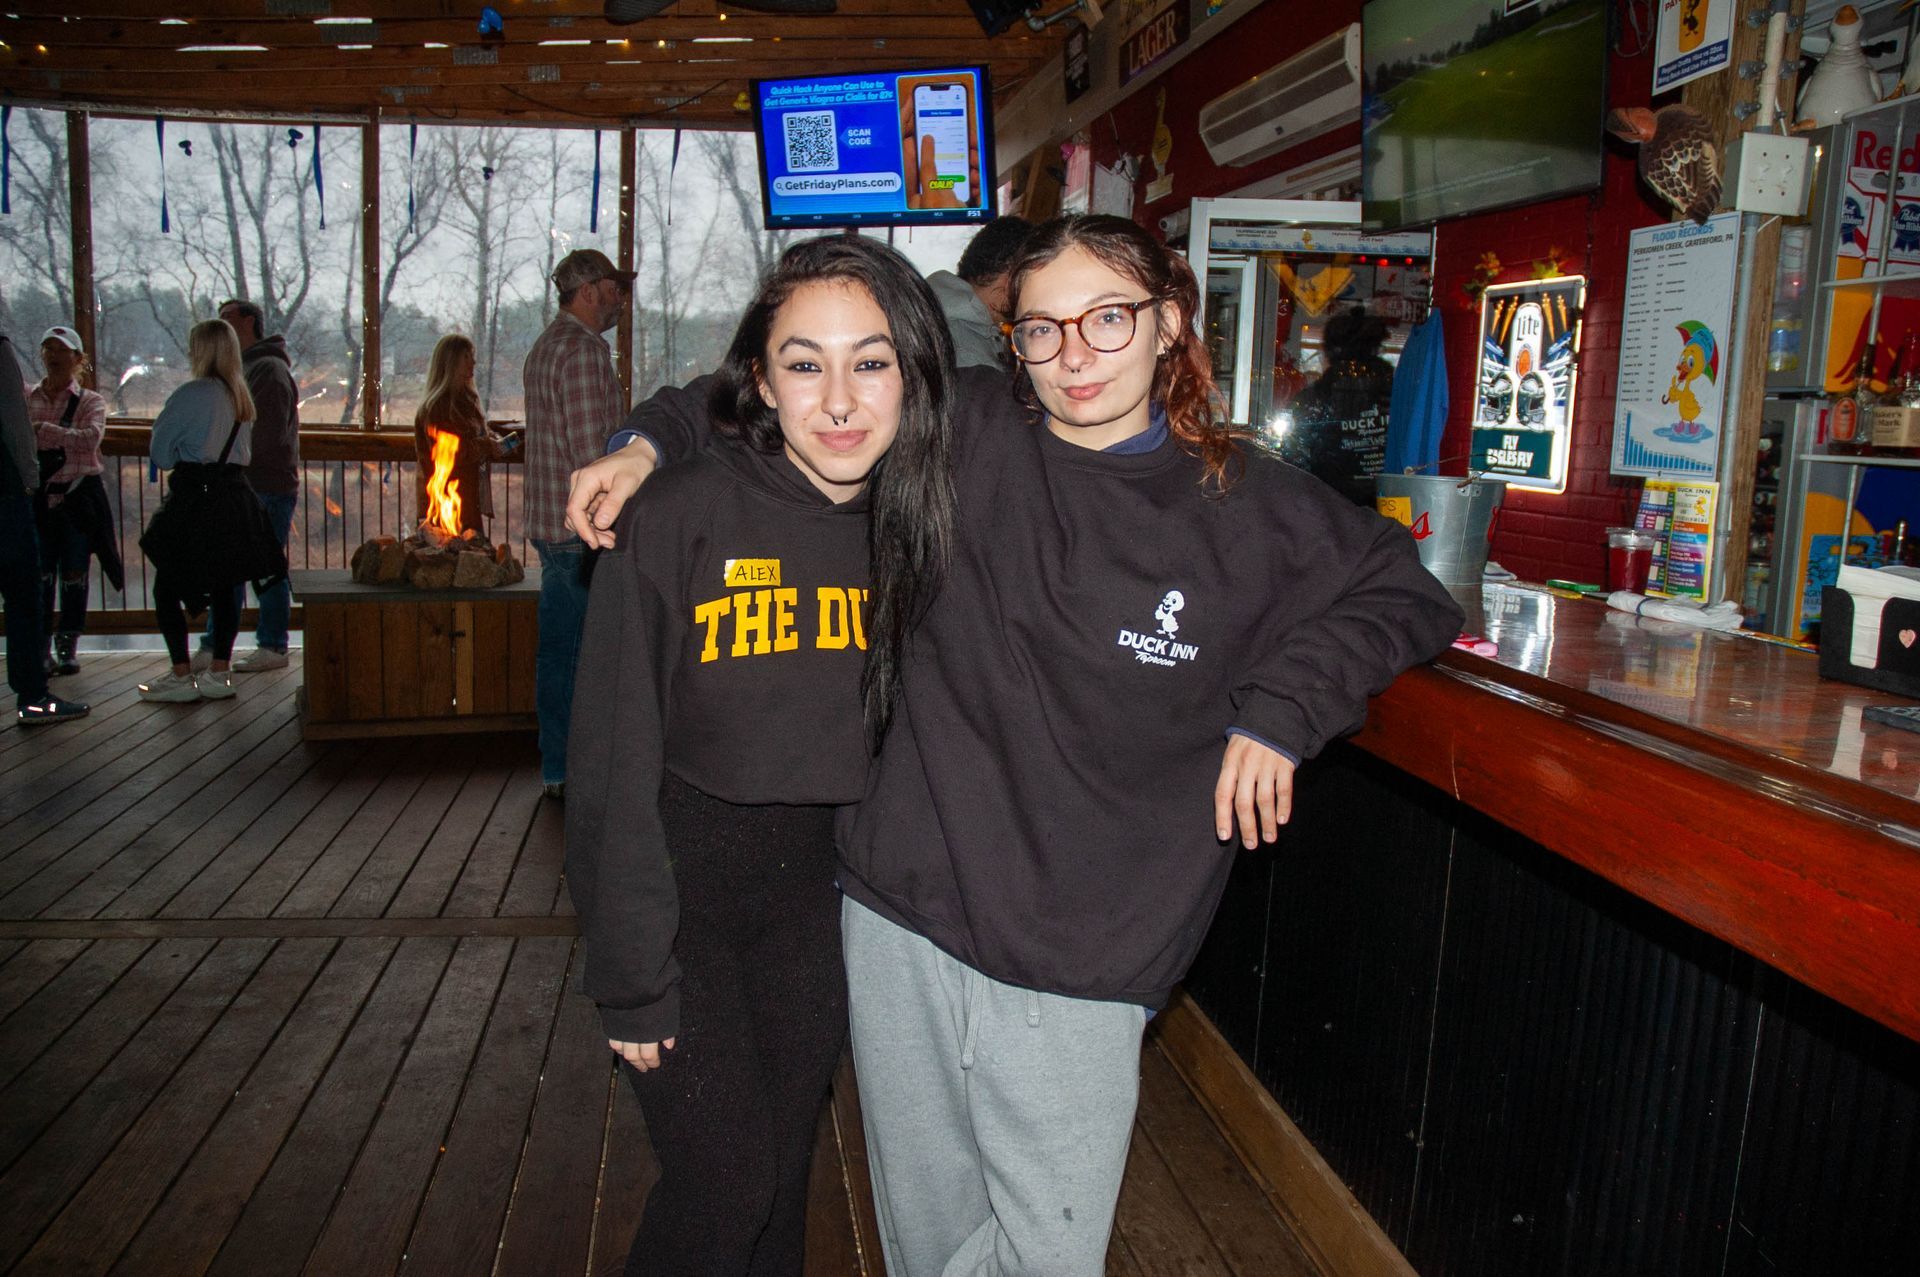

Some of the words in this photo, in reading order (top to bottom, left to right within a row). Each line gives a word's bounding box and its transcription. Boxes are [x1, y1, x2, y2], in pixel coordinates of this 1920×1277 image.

[1128, 10, 1177, 75] LAGER
[770, 86, 792, 95] Quick
[793, 85, 812, 94] Hack
[813, 83, 842, 94] Anyone
[843, 82, 860, 91] Can
[860, 81, 875, 89] Use
[876, 80, 885, 88] to
[764, 98, 778, 107] Get
[780, 96, 808, 105] Generic
[867, 91, 879, 100] for
[847, 128, 871, 137] SCAN
[848, 137, 872, 145] CODE
[785, 178, 895, 191] GetFridayPlans.com
[1652, 231, 1676, 242] FLOOD
[1678, 223, 1714, 239] RECORDS
[1633, 244, 1664, 256] PERKIOMEN
[1725, 233, 1734, 241] PA
[1516, 314, 1540, 341] Lite
[1341, 417, 1376, 431] DUCK
[1502, 434, 1519, 449] FLY
[1486, 448, 1517, 466] EAGLES
[1517, 451, 1534, 468] FLY
[735, 565, 777, 582] ALEX
[695, 588, 798, 663] THE
[1118, 629, 1169, 655] DUCK
[1170, 642, 1199, 661] INN
[1135, 650, 1176, 667] Taproom
